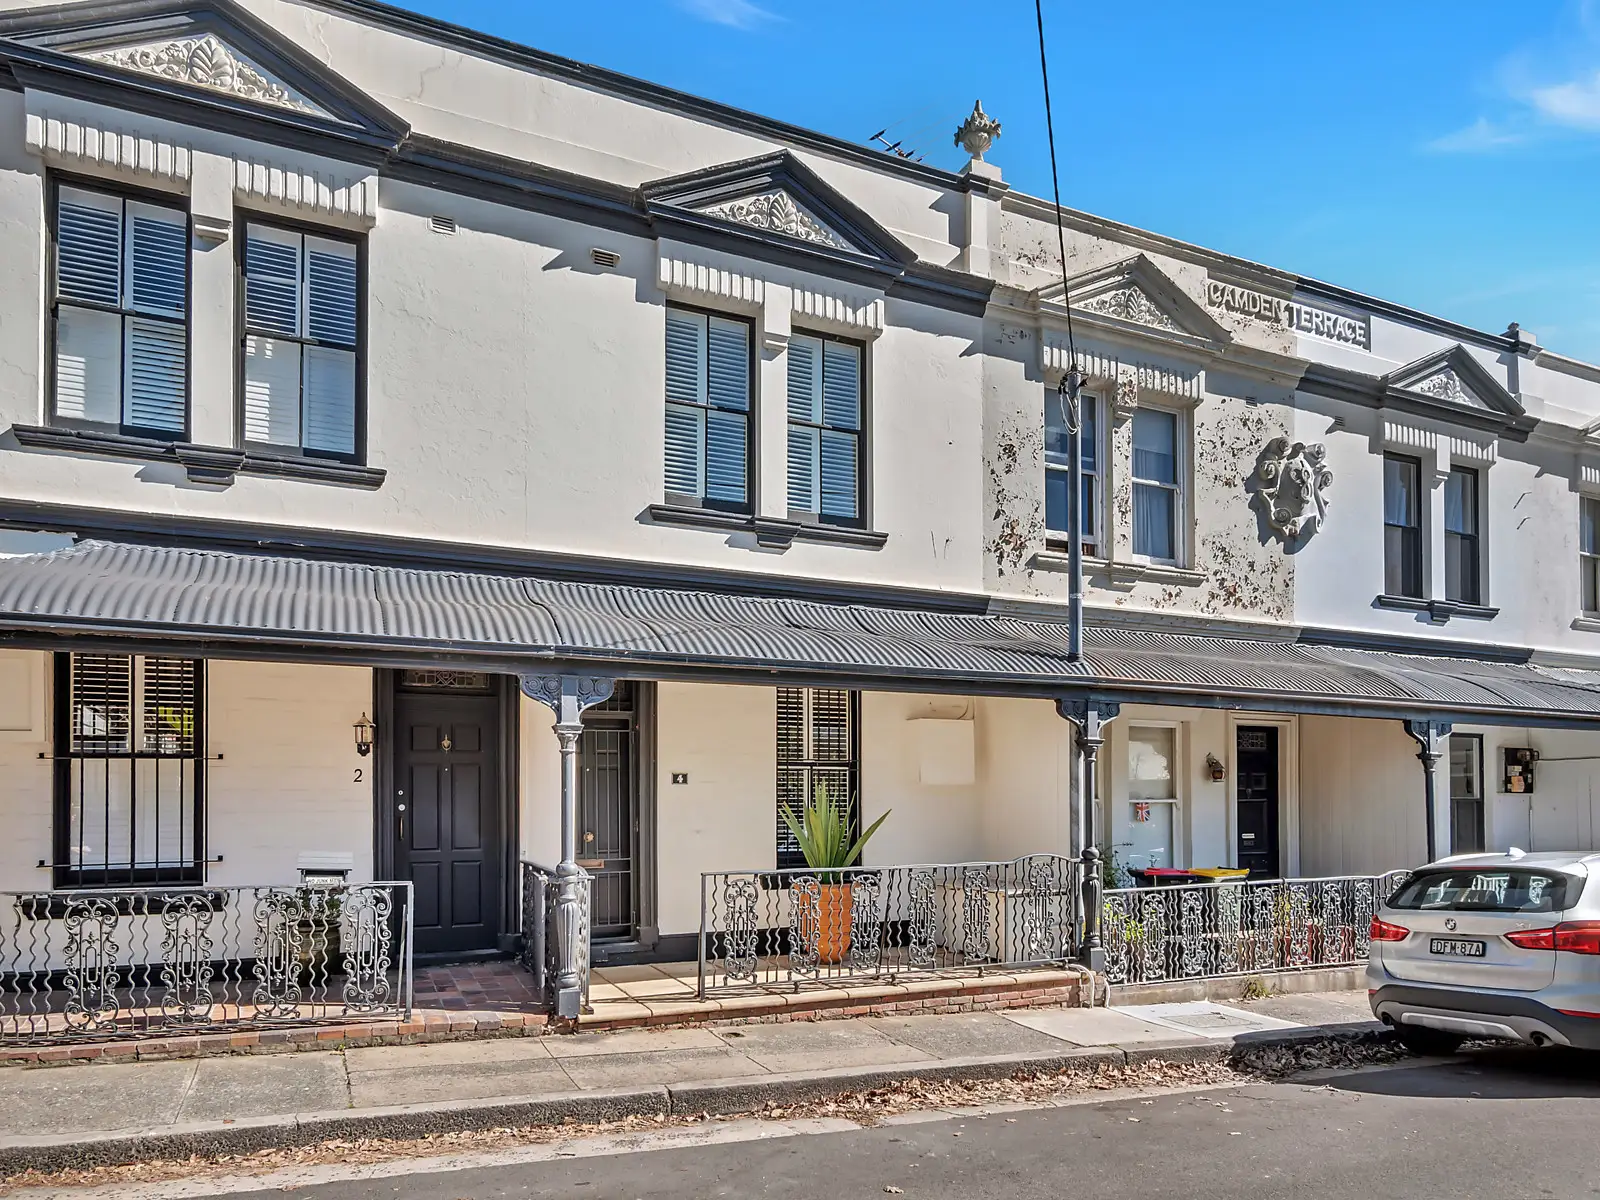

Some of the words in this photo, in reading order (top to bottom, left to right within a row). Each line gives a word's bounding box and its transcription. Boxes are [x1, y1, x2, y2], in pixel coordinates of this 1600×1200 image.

[1207, 282, 1285, 321] CAMDEN
[1285, 303, 1367, 343] TERRACE
[353, 768, 363, 783] 2
[676, 774, 684, 784] 4
